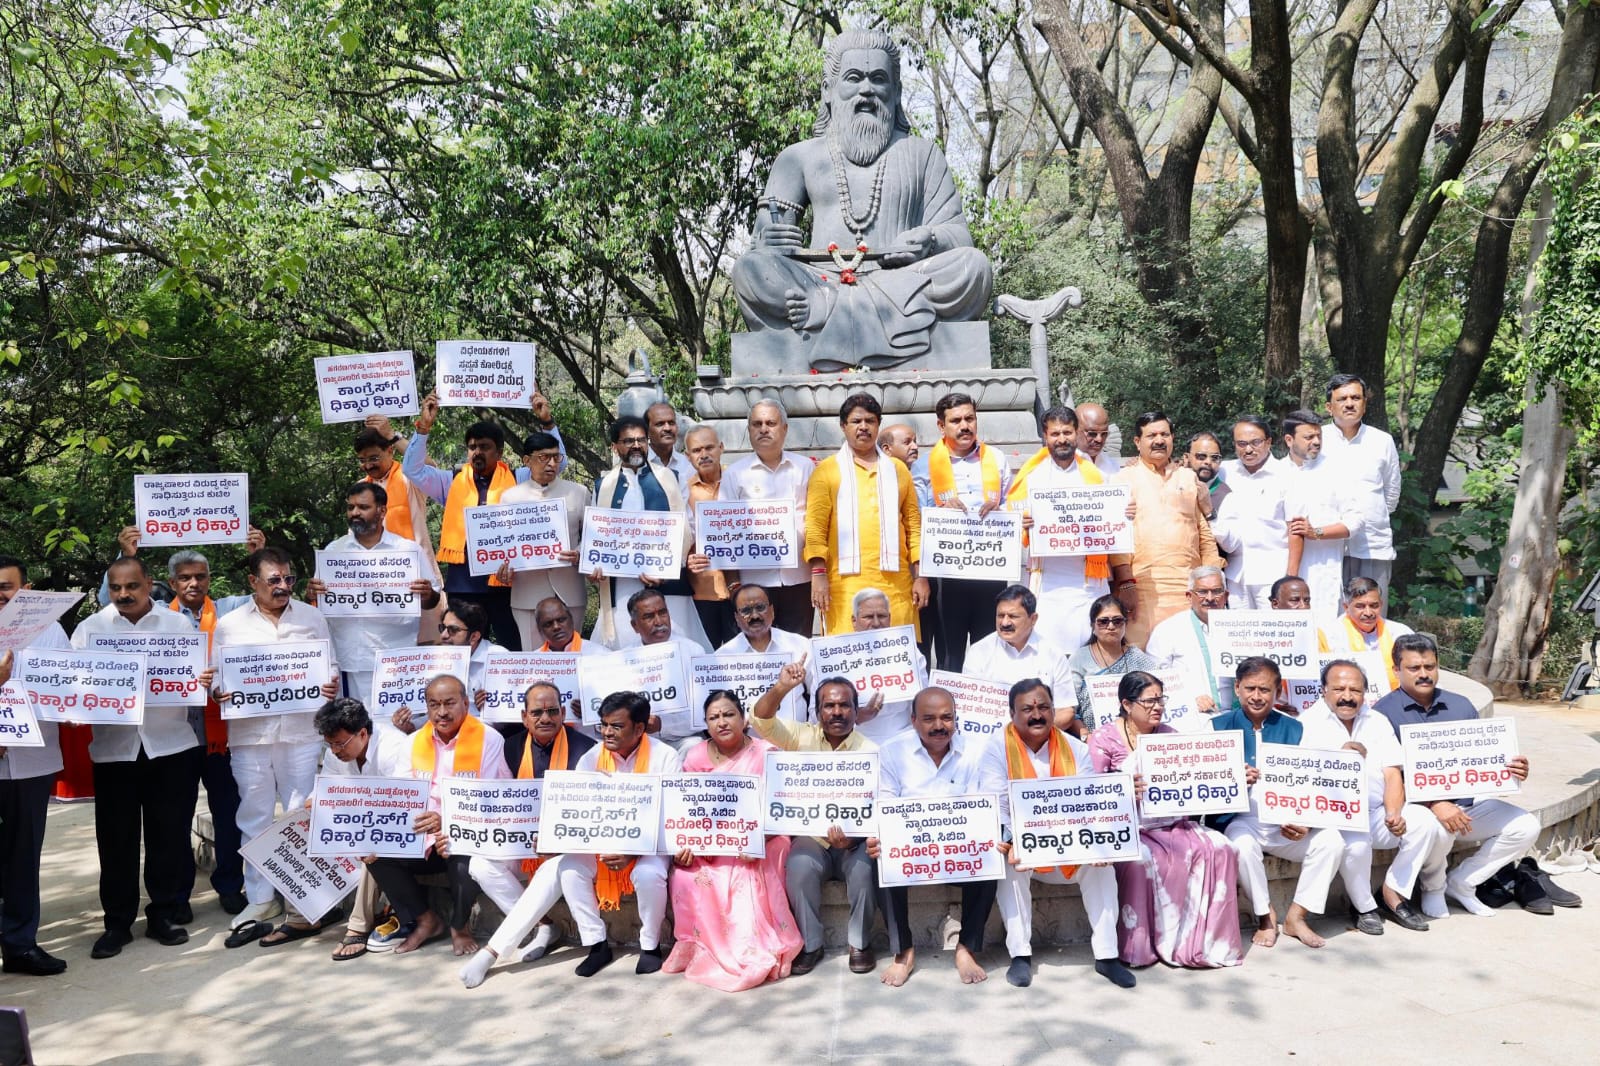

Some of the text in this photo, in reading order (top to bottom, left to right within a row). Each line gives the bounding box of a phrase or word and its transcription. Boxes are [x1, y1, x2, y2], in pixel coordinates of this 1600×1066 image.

[331, 392, 410, 413] ಧಿಕ್ಕಾರ ಧಿಕ್ಕಾರ
[1052, 502, 1104, 514] ನ್ಯಾಯಾಲಯ
[146, 516, 240, 537] ಧಿಕ್ಕಾರ ಧಿಕ್ಕಾರ
[1058, 514, 1102, 523] ಇಡಿ, ಸಿಬಿಐ
[1039, 522, 1125, 535] ವಿರೋಧಿ ಕಾಂಗ್ರೆಸ್
[476, 540, 562, 564] ಧಿಕ್ಕಾರ ಧಿಕ್ಕಾರ
[1050, 536, 1115, 551] ಧಿಕ್ಕಾರ ಧಿಕ್ಕಾರ
[588, 550, 673, 572] ಧಿಕ್ಕಾರ ಧಿಕ್ಕಾರ
[933, 553, 1006, 570] ಧಿಕ್ಕಾರವಿರಲಿ
[324, 591, 414, 609] ಧಿಕ್ಕಾರ ಧಿಕ್ಕಾರ
[820, 636, 910, 658] ಪ್ರಜಾಪ್ರಭುತ್ವ ವಿರೋಧಿ
[28, 658, 138, 672] ಪ್ರಜಾಪ್ರಭುತ್ವ ವಿರೋಧಿ
[822, 652, 912, 672] ಕಾಂಗ್ರೆಸ್ ಸರ್ಕಾರಕ್ಕೆ
[25, 673, 136, 691] ಕಾಂಗ್ರೆಸ್ ಸರ್ಕಾರಕ್ಕೆ
[151, 679, 199, 698] ಧಿಕ್ಕಾರ
[870, 671, 914, 690] ಧಿಕ್ಕಾರ
[84, 694, 135, 715] ಧಿಕ್ಕಾರ
[487, 690, 515, 708] ಭ್ರಷ್ಟ
[776, 761, 872, 775] ರಾಜ್ಯಪಾಲರ ಹೆಸರಲ್ಲಿ
[1266, 755, 1361, 773] ಪ್ರಜಾಪ್ರಭುತ್ವ ವಿರೋಧಿ
[1416, 757, 1458, 770] ಕಾಂಗ್ರೆಸ್
[785, 777, 864, 787] ನೀಚ ರಾಜಕಾರಣ
[1265, 773, 1360, 794] ಕಾಂಗ್ರೆಸ್ ಸರ್ಕಾರಕ್ಕೆ
[1414, 766, 1511, 791] ಧಿಕ್ಕಾರ ಧಿಕ್ಕಾರ
[450, 787, 540, 802] ರಾಜ್ಯಪಾಲರ ಹೆಸರಲ್ಲಿ
[682, 792, 738, 806] ನ್ಯಾಯಾಲಯ
[1022, 784, 1124, 802] ರಾಜ್ಯಪಾಲರ ಹೆಸರಲ್ಲಿ
[458, 802, 532, 814] ನೀಚ ರಾಜಕಾರಣ
[688, 807, 736, 817] ಇಡಿ, ಸಿಬಿಐ
[770, 802, 873, 826] ಧಿಕ್ಕಾರ ಧಿಕ್ಕಾರ
[1033, 800, 1118, 815] ನೀಚ ರಾಜಕಾರಣ
[1265, 792, 1360, 819] ಧಿಕ್ಕಾರ ಧಿಕ್ಕಾರ
[666, 817, 760, 833] ವಿರೋಧಿ ಕಾಂಗ್ರೆಸ್
[904, 815, 967, 832] ನ್ಯಾಯಾಲಯ
[1068, 816, 1096, 826] ಕಾಂಗ್ರೆಸ್
[1099, 813, 1131, 823] ಸರ್ಕಾರಕ್ಕೆ
[320, 828, 417, 848] ಧಿಕ್ಕಾರ ಧಿಕ್ಕಾರ
[449, 825, 488, 846] ಧಿಕ್ಕಾರ
[554, 823, 641, 842] ಧಿಕ್ಕಾರವಿರಲಿ
[912, 832, 966, 844] ಇಡಿ, ಸಿಬಿಐ
[1022, 826, 1130, 854] ಧಿಕ್ಕಾರ ಧಿಕ್ಕಾರ
[677, 834, 749, 851] ಧಿಕ್ಕಾರ ಧಿಕ್ಕಾರ
[889, 840, 994, 858] ವಿರೋಧಿ ಕಾಂಗ್ರೆಸ್
[902, 858, 982, 878] ಧಿಕ್ಕಾರ ಧಿಕ್ಕಾರ
